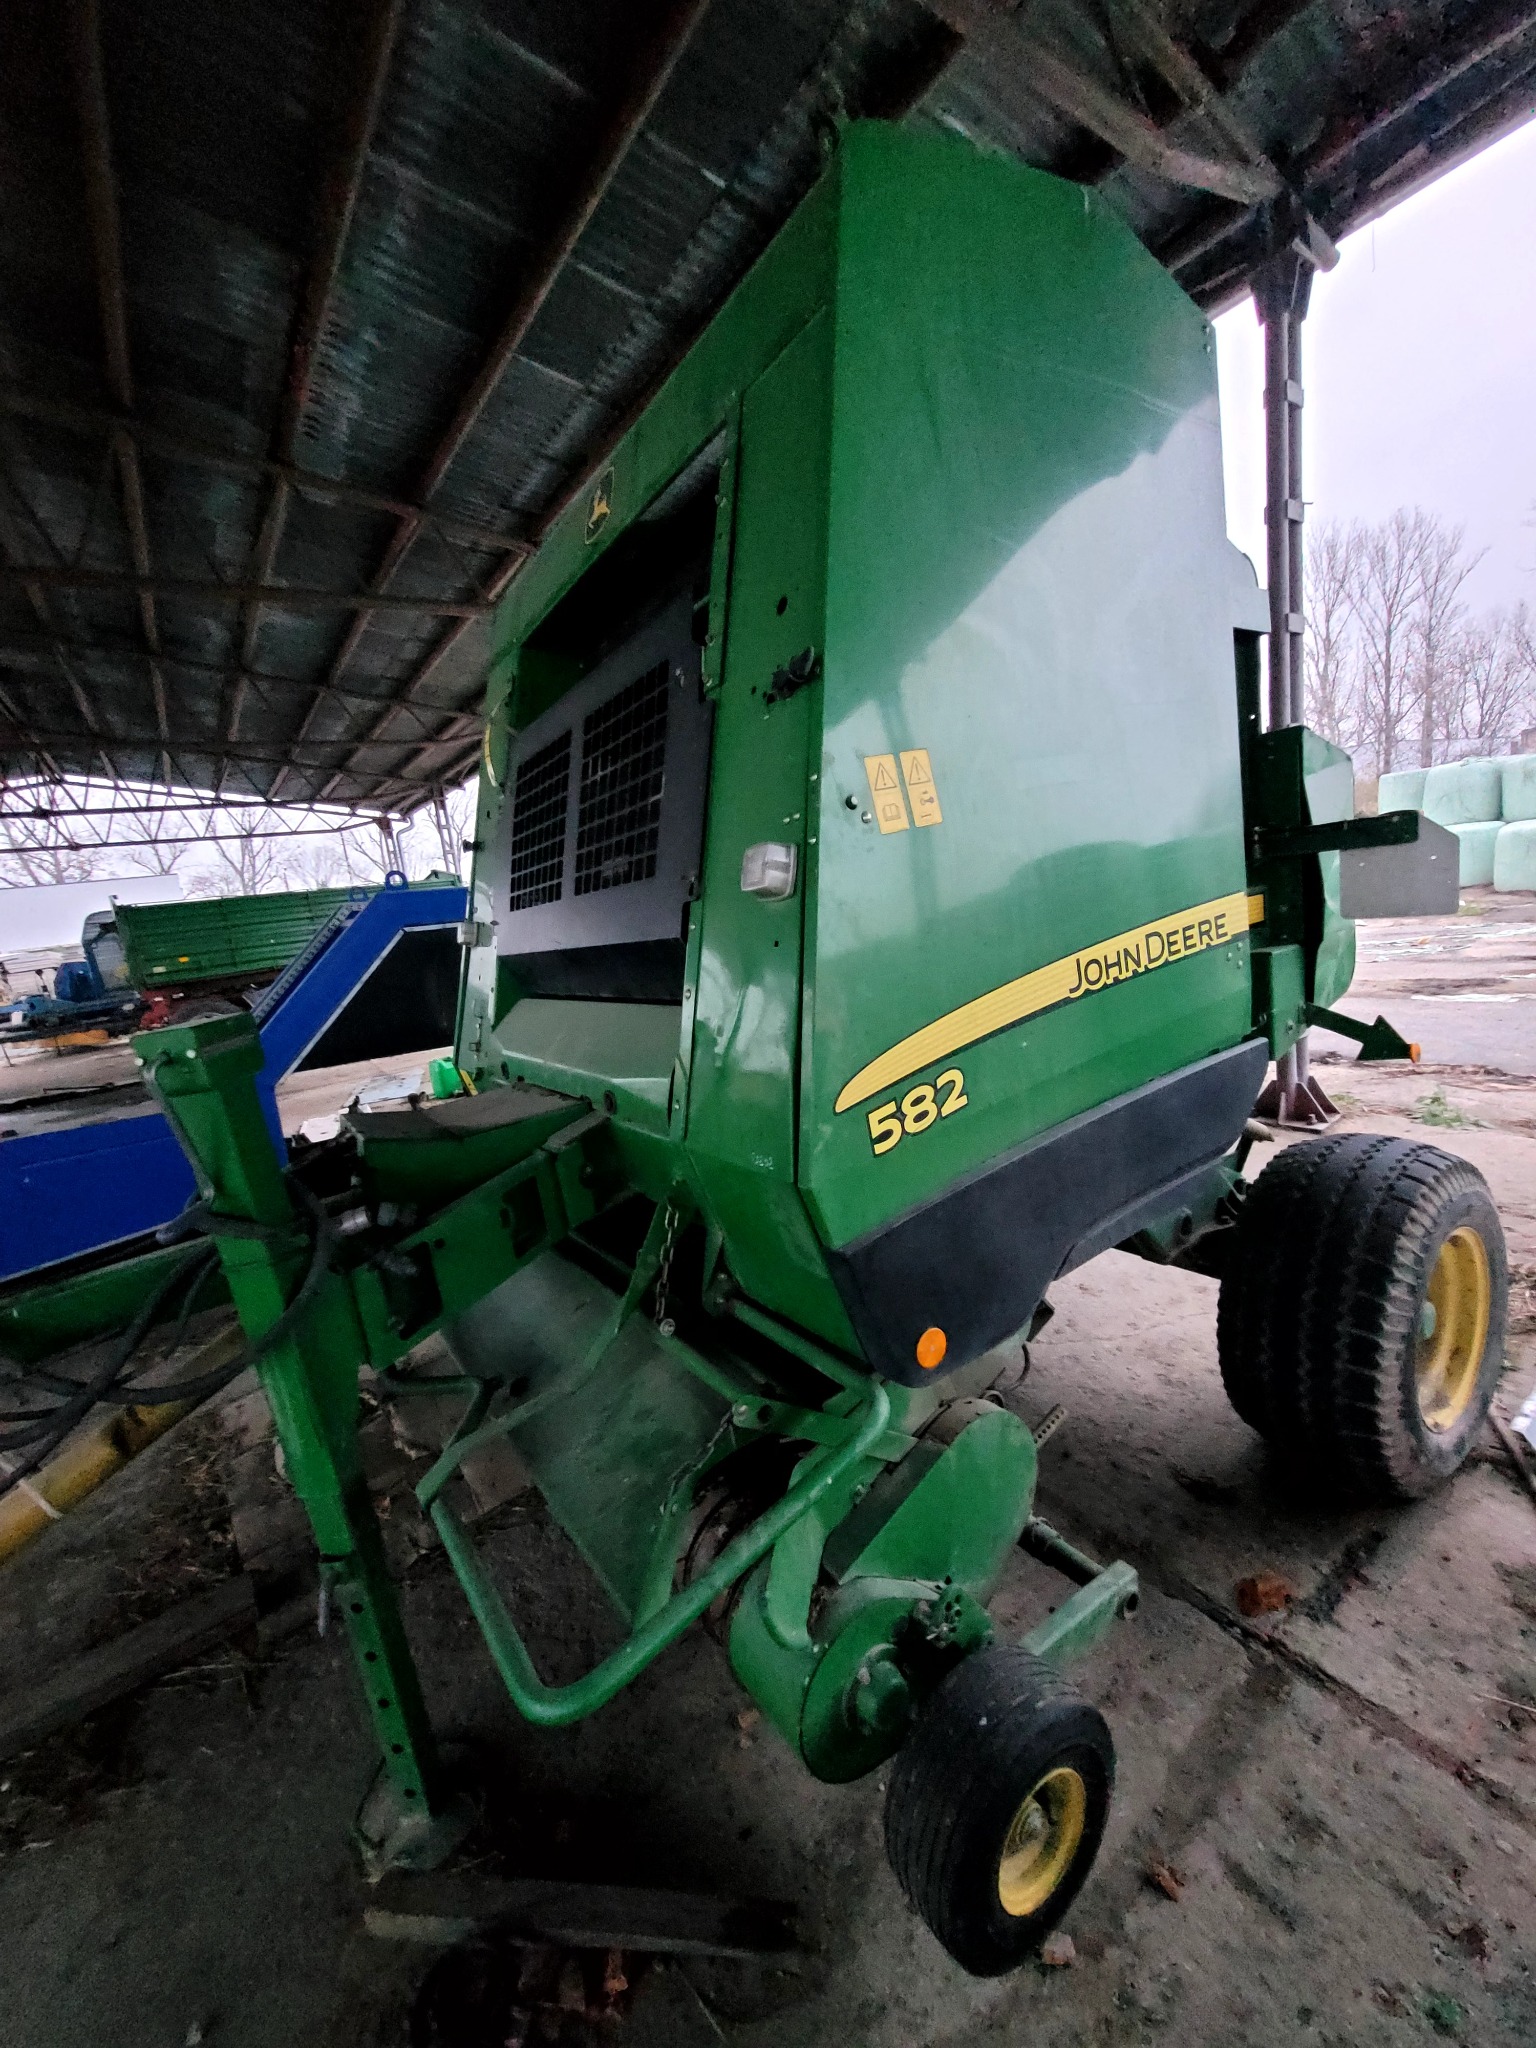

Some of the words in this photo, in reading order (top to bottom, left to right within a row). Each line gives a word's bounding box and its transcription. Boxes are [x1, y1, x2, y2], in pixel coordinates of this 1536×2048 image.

[1068, 943, 1142, 994] JOHN
[1145, 912, 1229, 965] DEERE
[867, 1068, 969, 1156] 582
